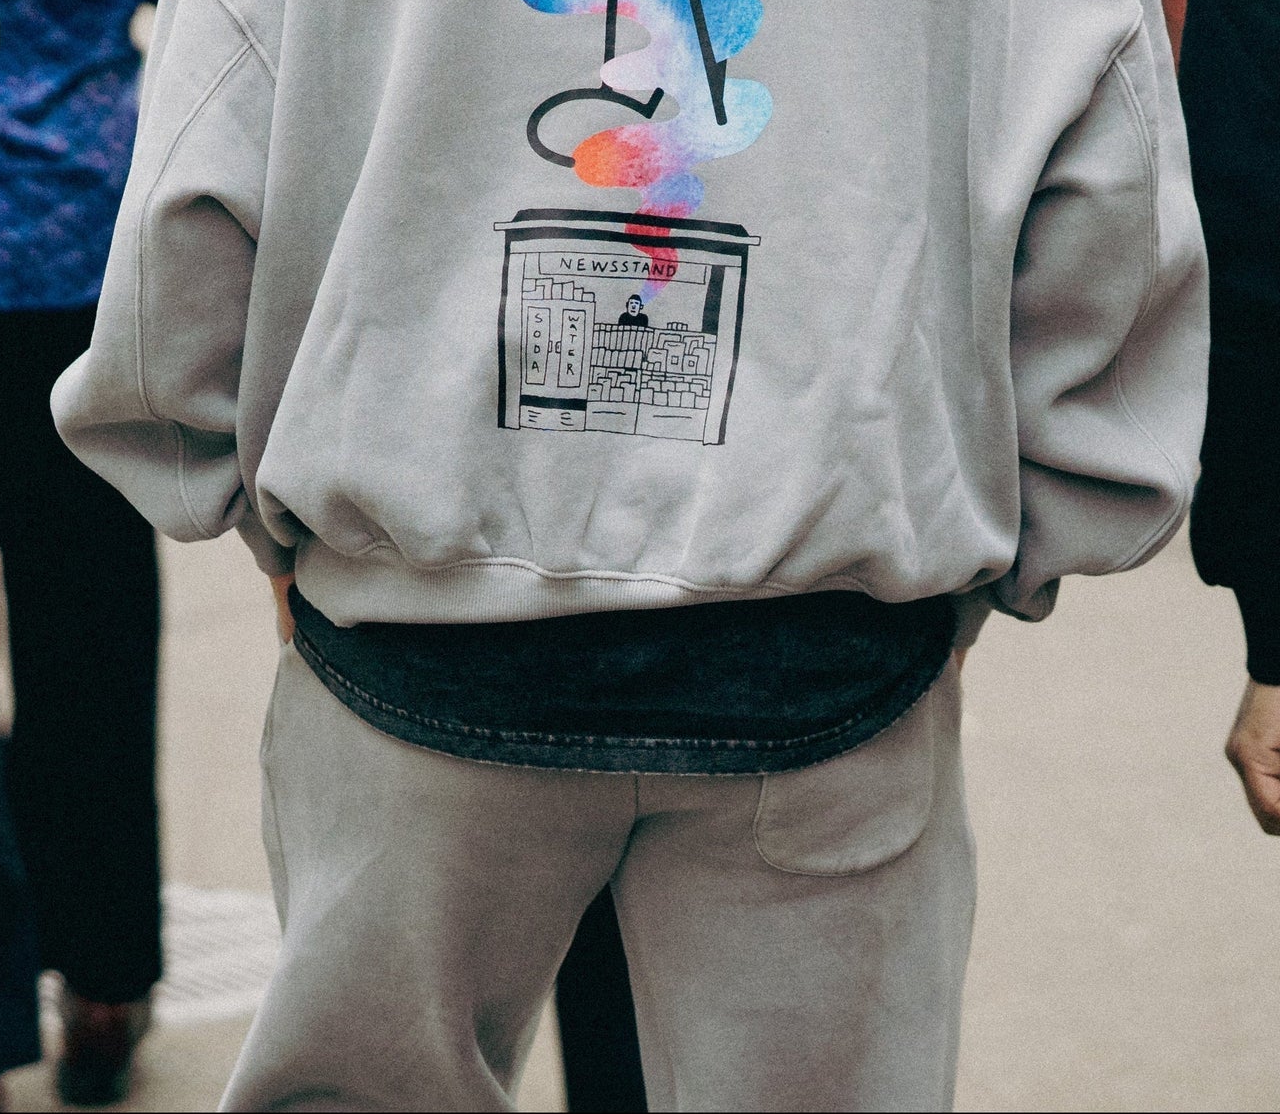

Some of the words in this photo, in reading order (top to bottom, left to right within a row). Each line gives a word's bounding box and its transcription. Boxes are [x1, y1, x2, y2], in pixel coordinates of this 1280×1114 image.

[558, 257, 677, 277] NEWSSTAND
[531, 313, 543, 373] SODA
[566, 315, 580, 376] WATER
